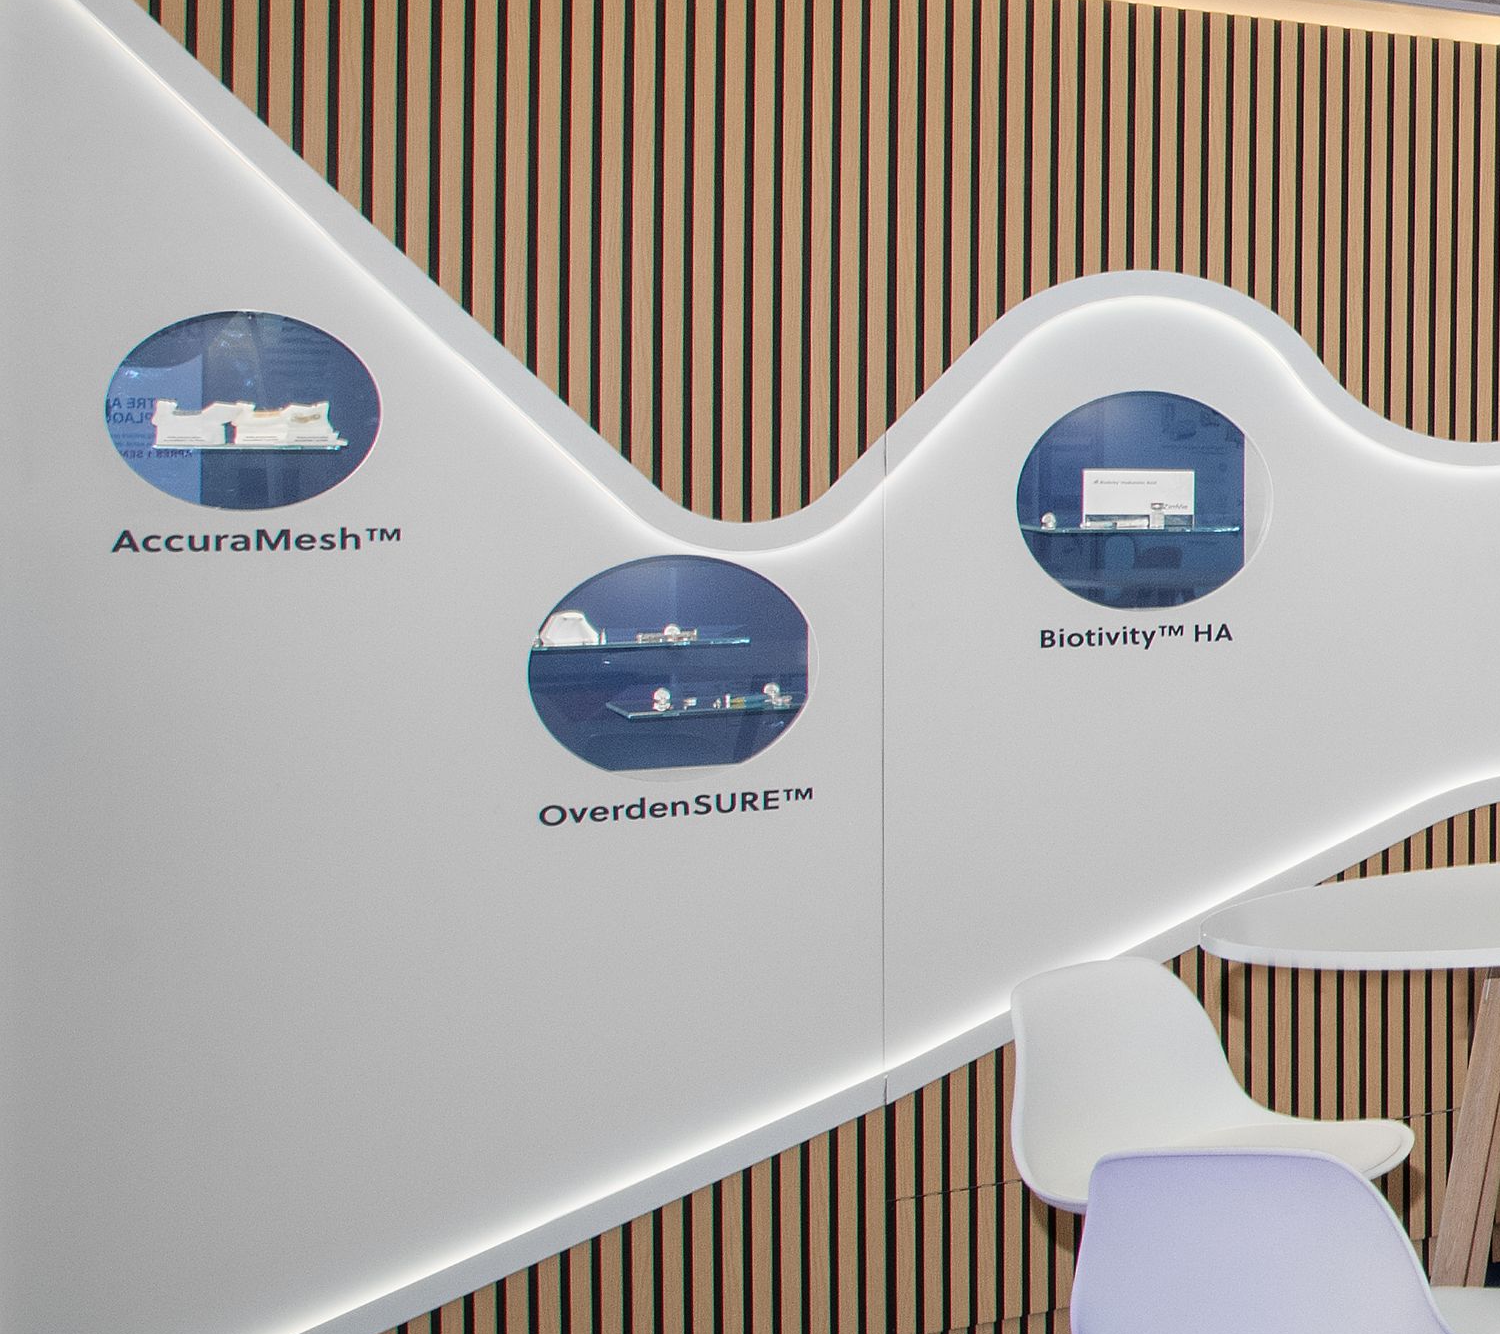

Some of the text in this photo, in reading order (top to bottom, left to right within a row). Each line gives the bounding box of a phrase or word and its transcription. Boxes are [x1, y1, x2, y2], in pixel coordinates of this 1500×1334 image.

[112, 527, 401, 553] AccuraMesh™
[1040, 623, 1233, 650] Biotivity™ HA
[539, 787, 813, 827] OverdenSURE™
